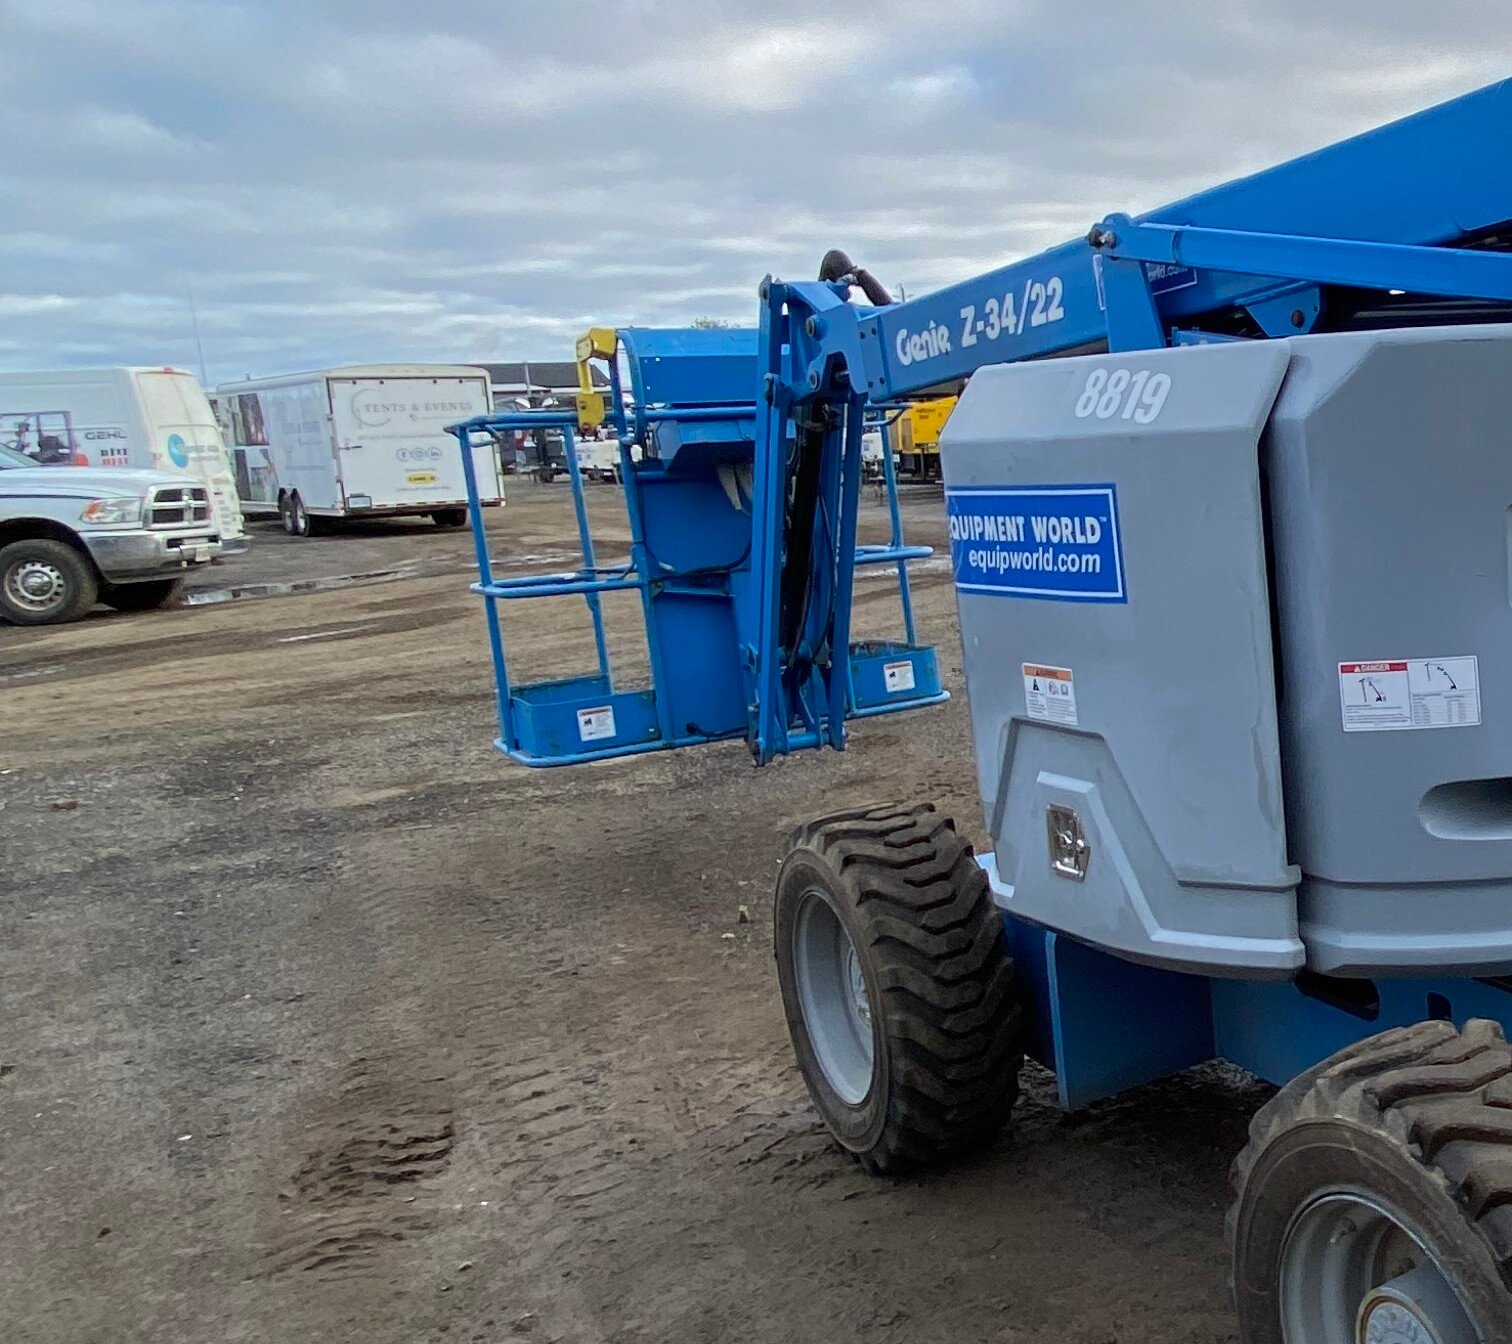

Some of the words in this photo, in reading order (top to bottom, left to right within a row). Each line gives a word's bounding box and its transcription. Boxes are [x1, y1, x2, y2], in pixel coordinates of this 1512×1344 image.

[896, 319, 951, 366] Genie
[960, 276, 1065, 348] Z-34/22
[363, 402, 406, 413] TENTS
[411, 402, 419, 412] &
[425, 401, 472, 412] EVENTS
[1074, 367, 1172, 424] 8819
[949, 514, 1025, 542] QUIPMENT
[1031, 516, 1101, 544] WORLD
[969, 545, 1101, 575] equipworld.com
